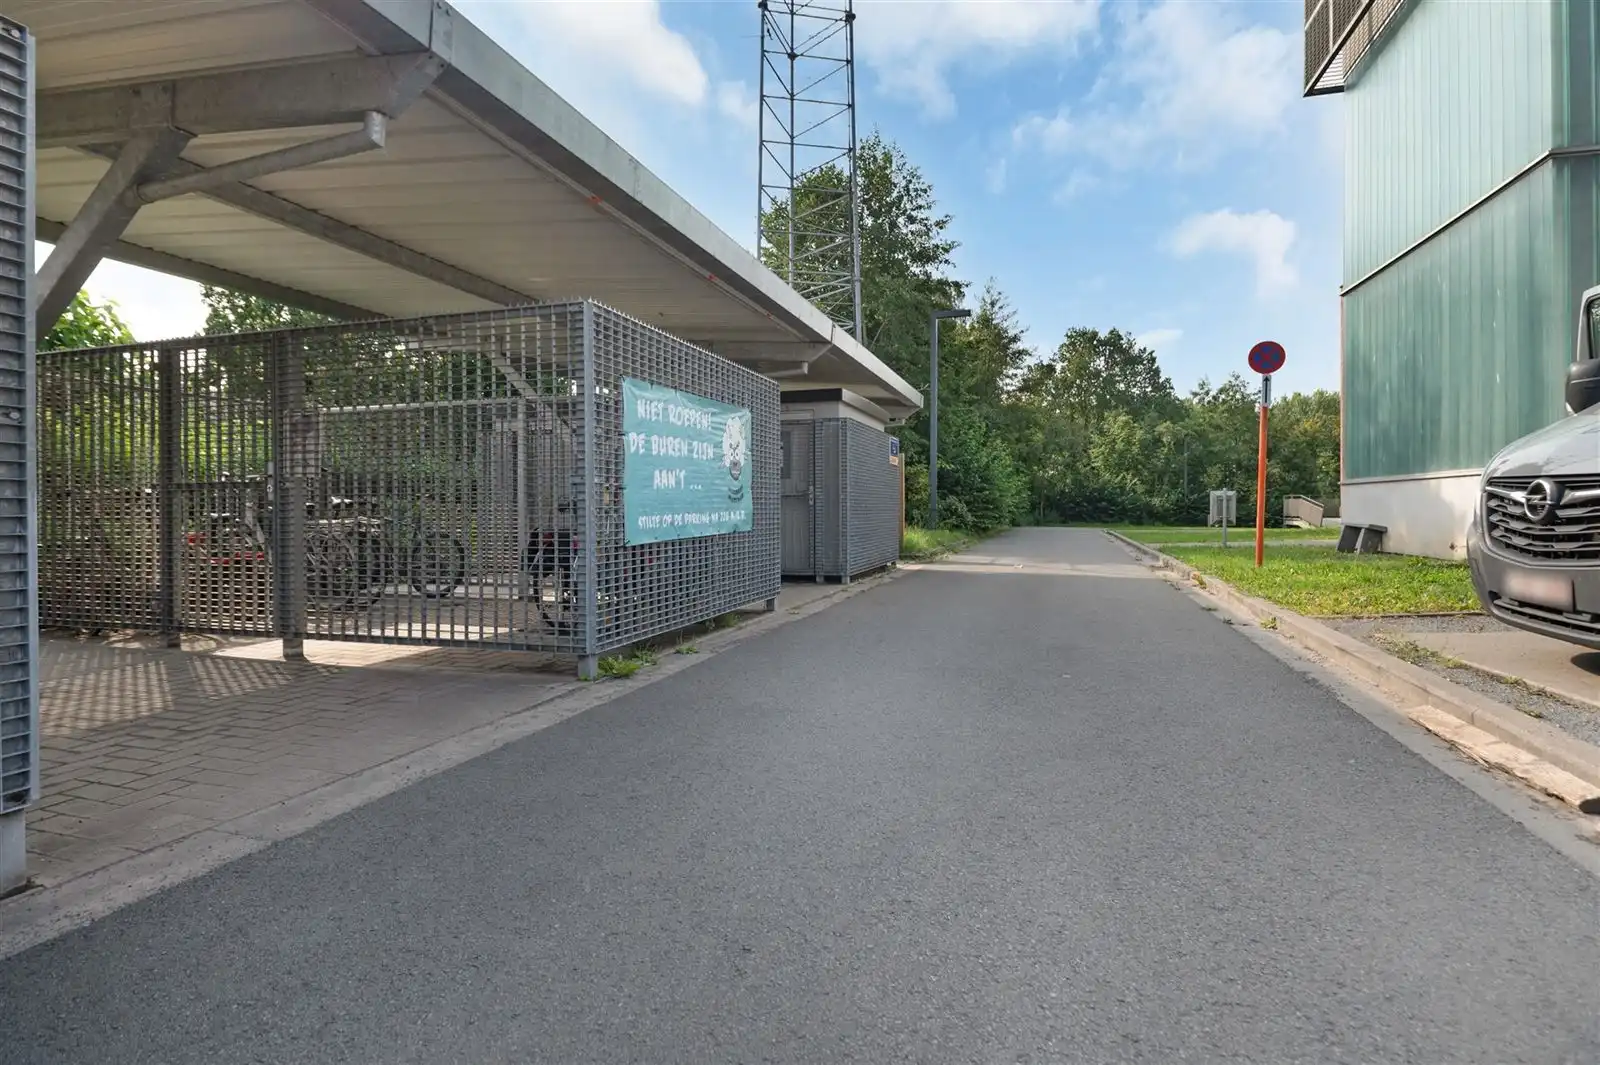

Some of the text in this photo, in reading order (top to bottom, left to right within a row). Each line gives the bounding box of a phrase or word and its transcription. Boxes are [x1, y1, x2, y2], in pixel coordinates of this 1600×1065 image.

[637, 398, 712, 431] NIET ROEPEN!
[628, 432, 714, 461] DE BUREN ZIJN
[653, 468, 686, 490] AAN'T
[663, 512, 672, 528] OP
